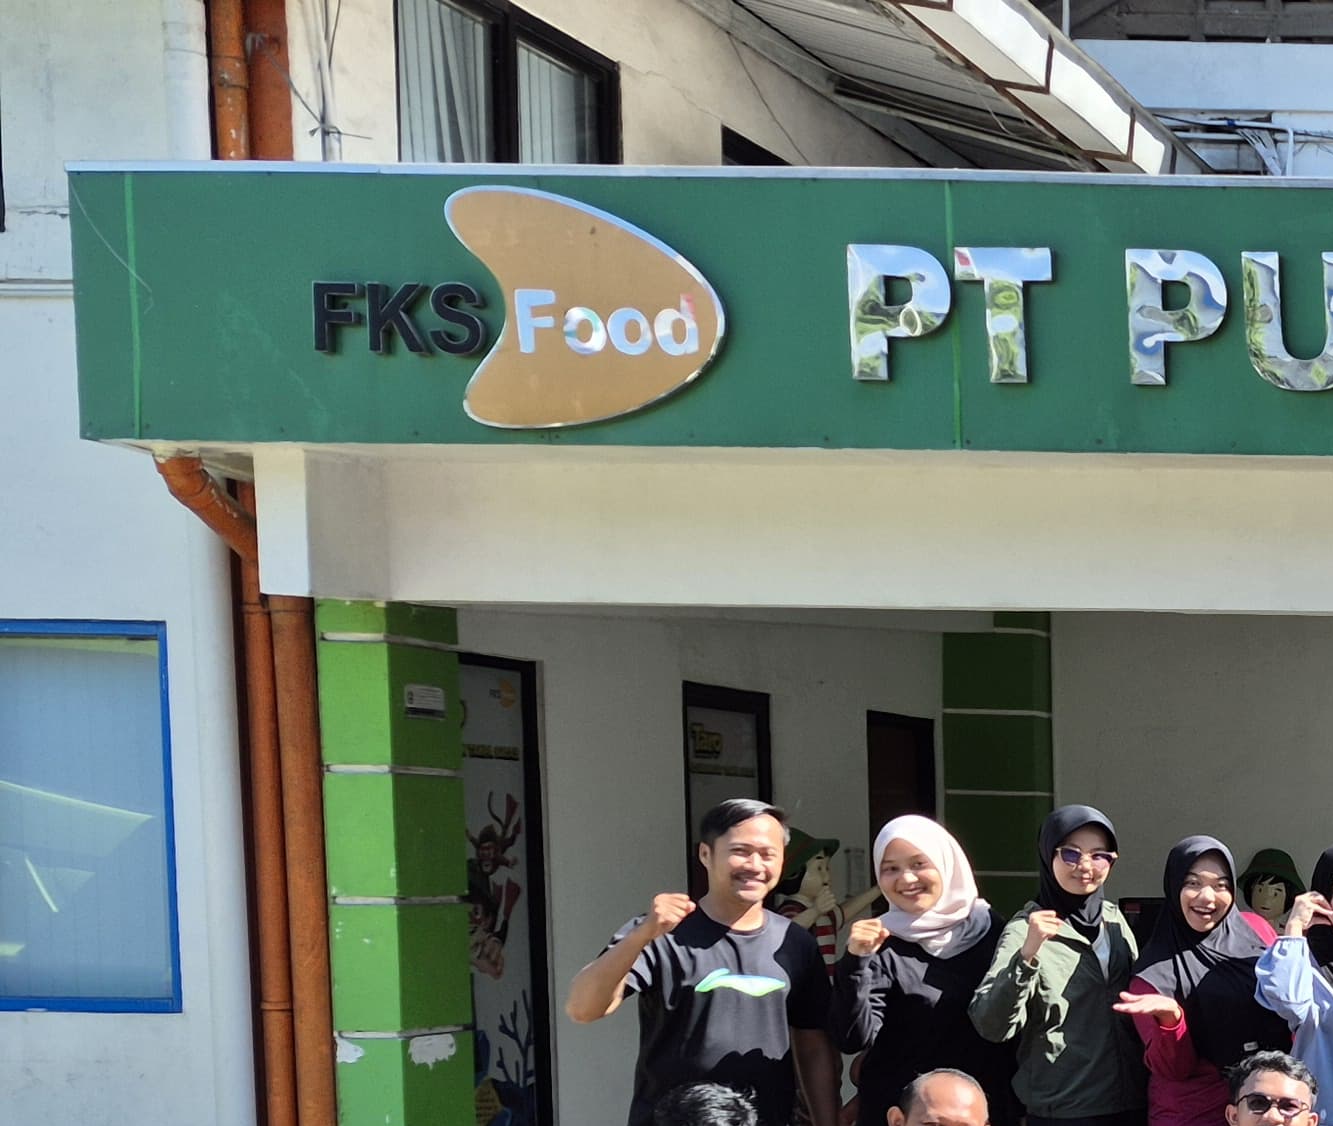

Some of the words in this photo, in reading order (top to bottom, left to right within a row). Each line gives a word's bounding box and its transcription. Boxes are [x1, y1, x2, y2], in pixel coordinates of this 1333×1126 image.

[312, 281, 490, 356] FKS
[514, 288, 699, 356] Food
[846, 243, 1053, 386] PT
